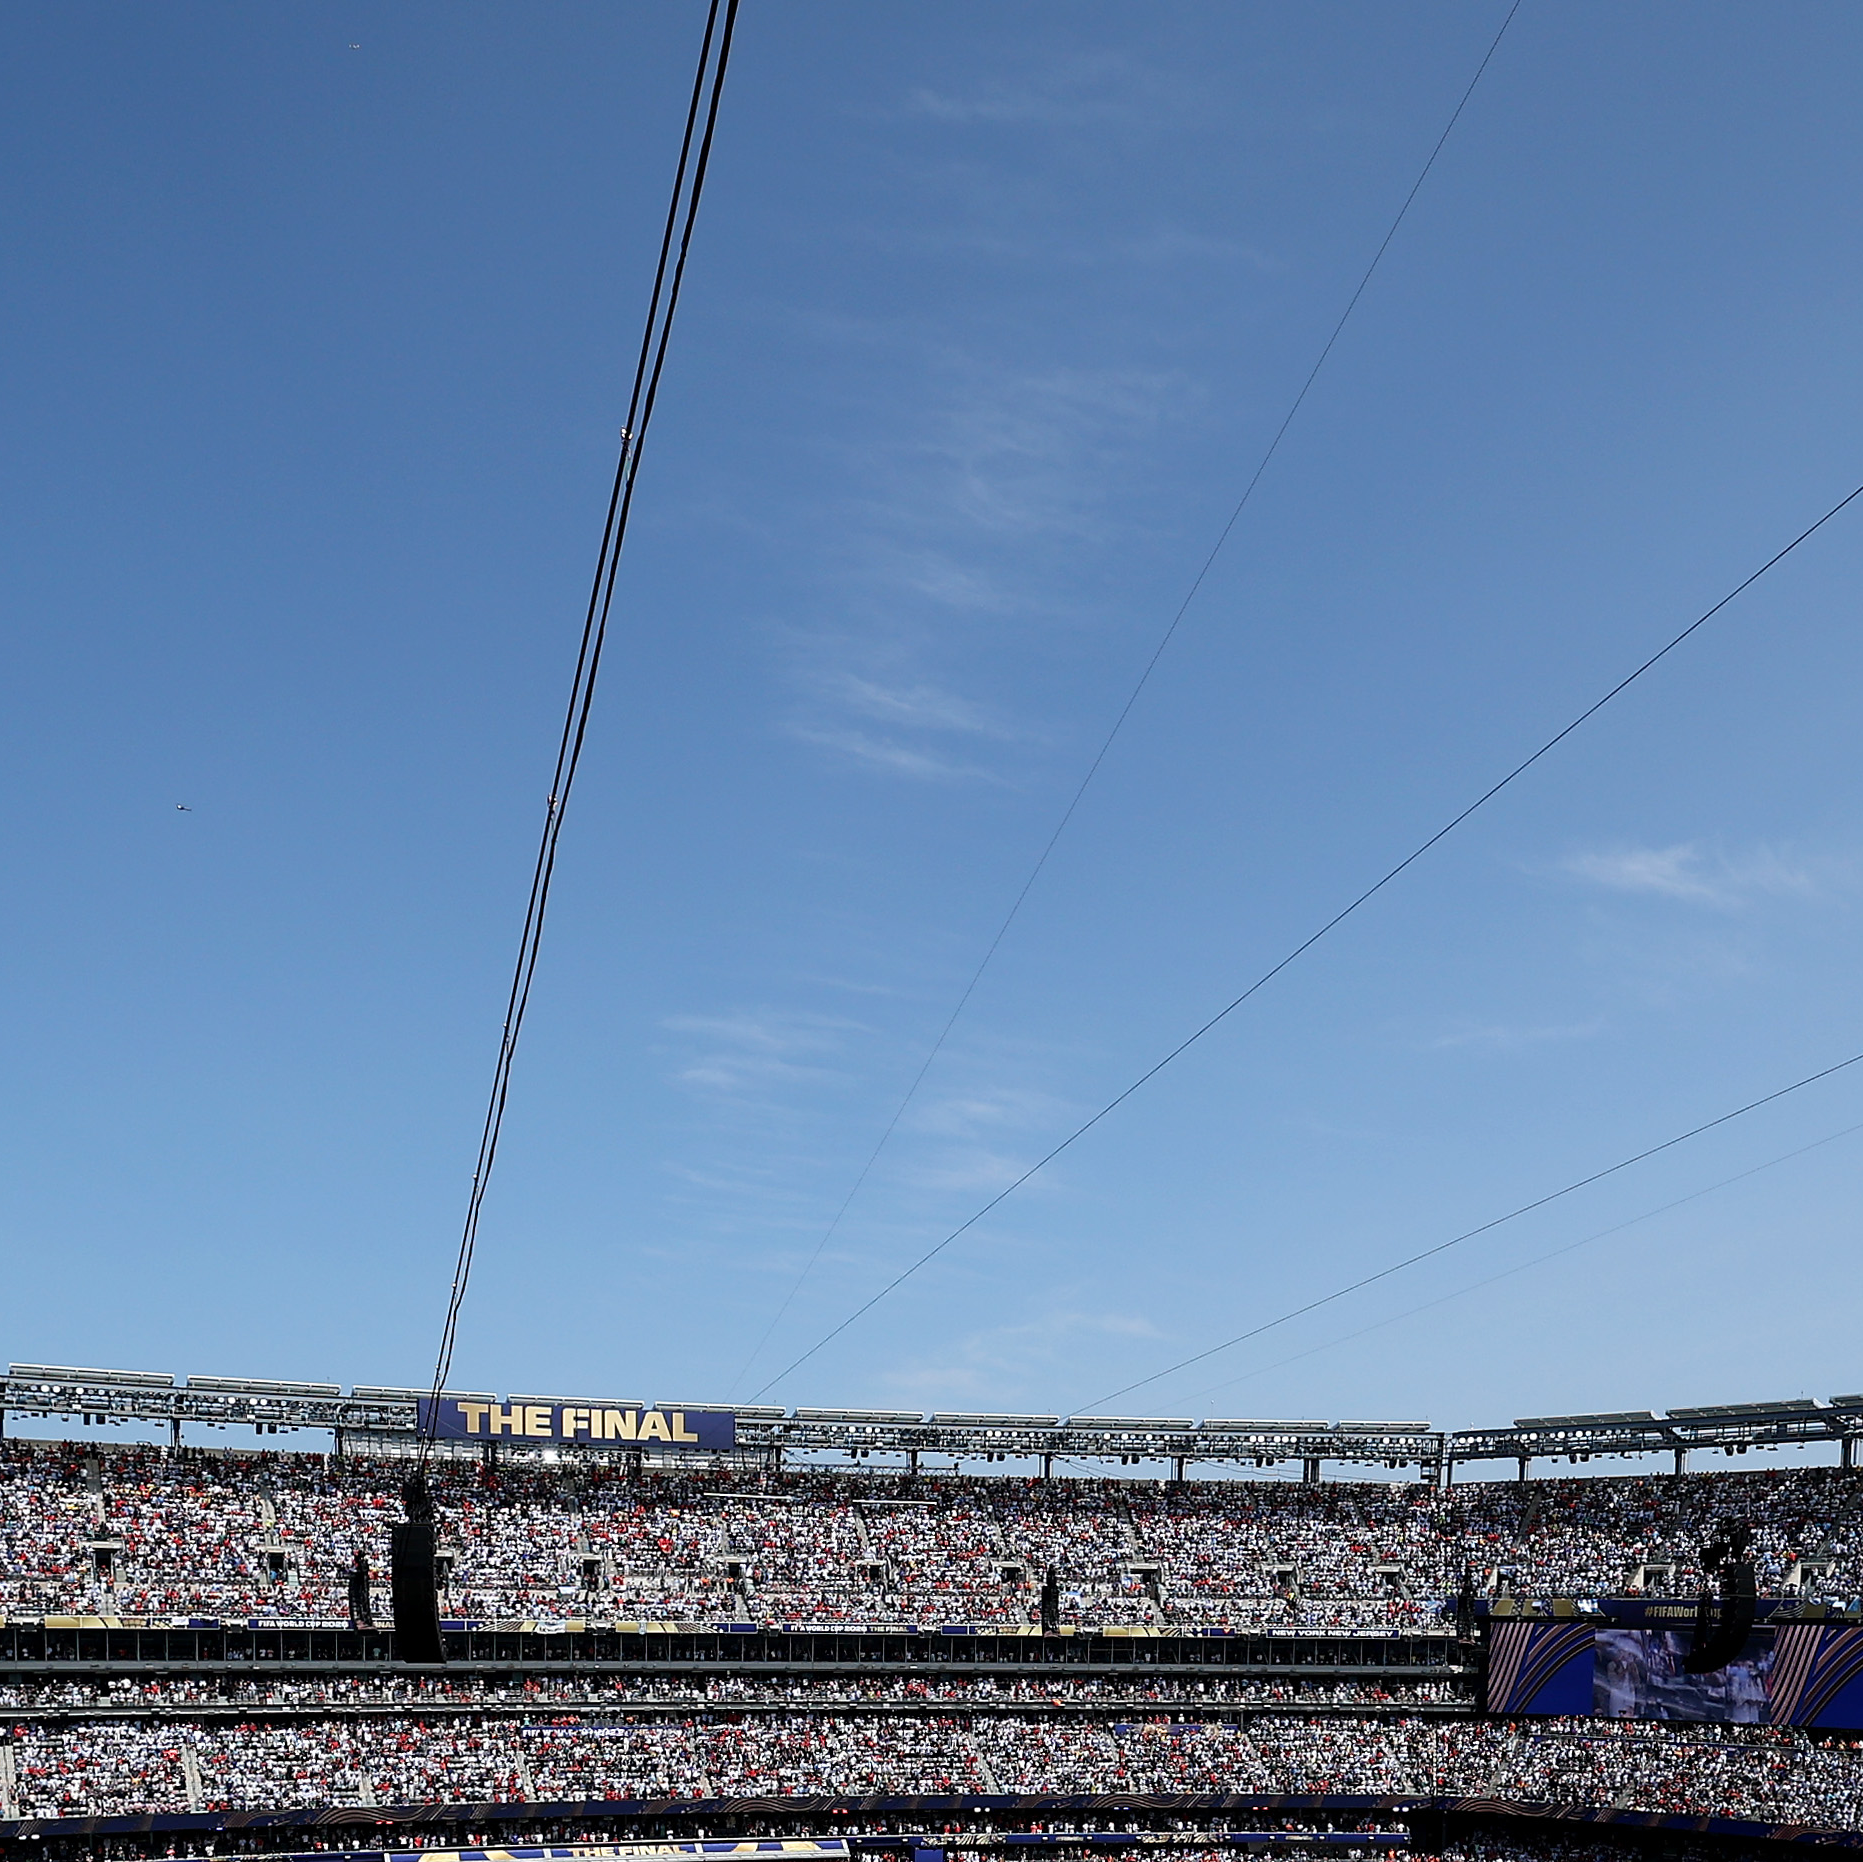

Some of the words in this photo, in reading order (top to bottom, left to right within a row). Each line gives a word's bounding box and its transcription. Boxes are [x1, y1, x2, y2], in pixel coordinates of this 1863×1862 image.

[457, 1402, 552, 1438] THE
[562, 1405, 699, 1442] FINAL
[1645, 1605, 1723, 1619] #FIFAWorlup
[258, 1620, 276, 1628] FIFA
[276, 1620, 304, 1628] WORLD
[305, 1620, 320, 1628] CUP
[567, 1846, 615, 1857] THE
[619, 1845, 688, 1856] FINAL
